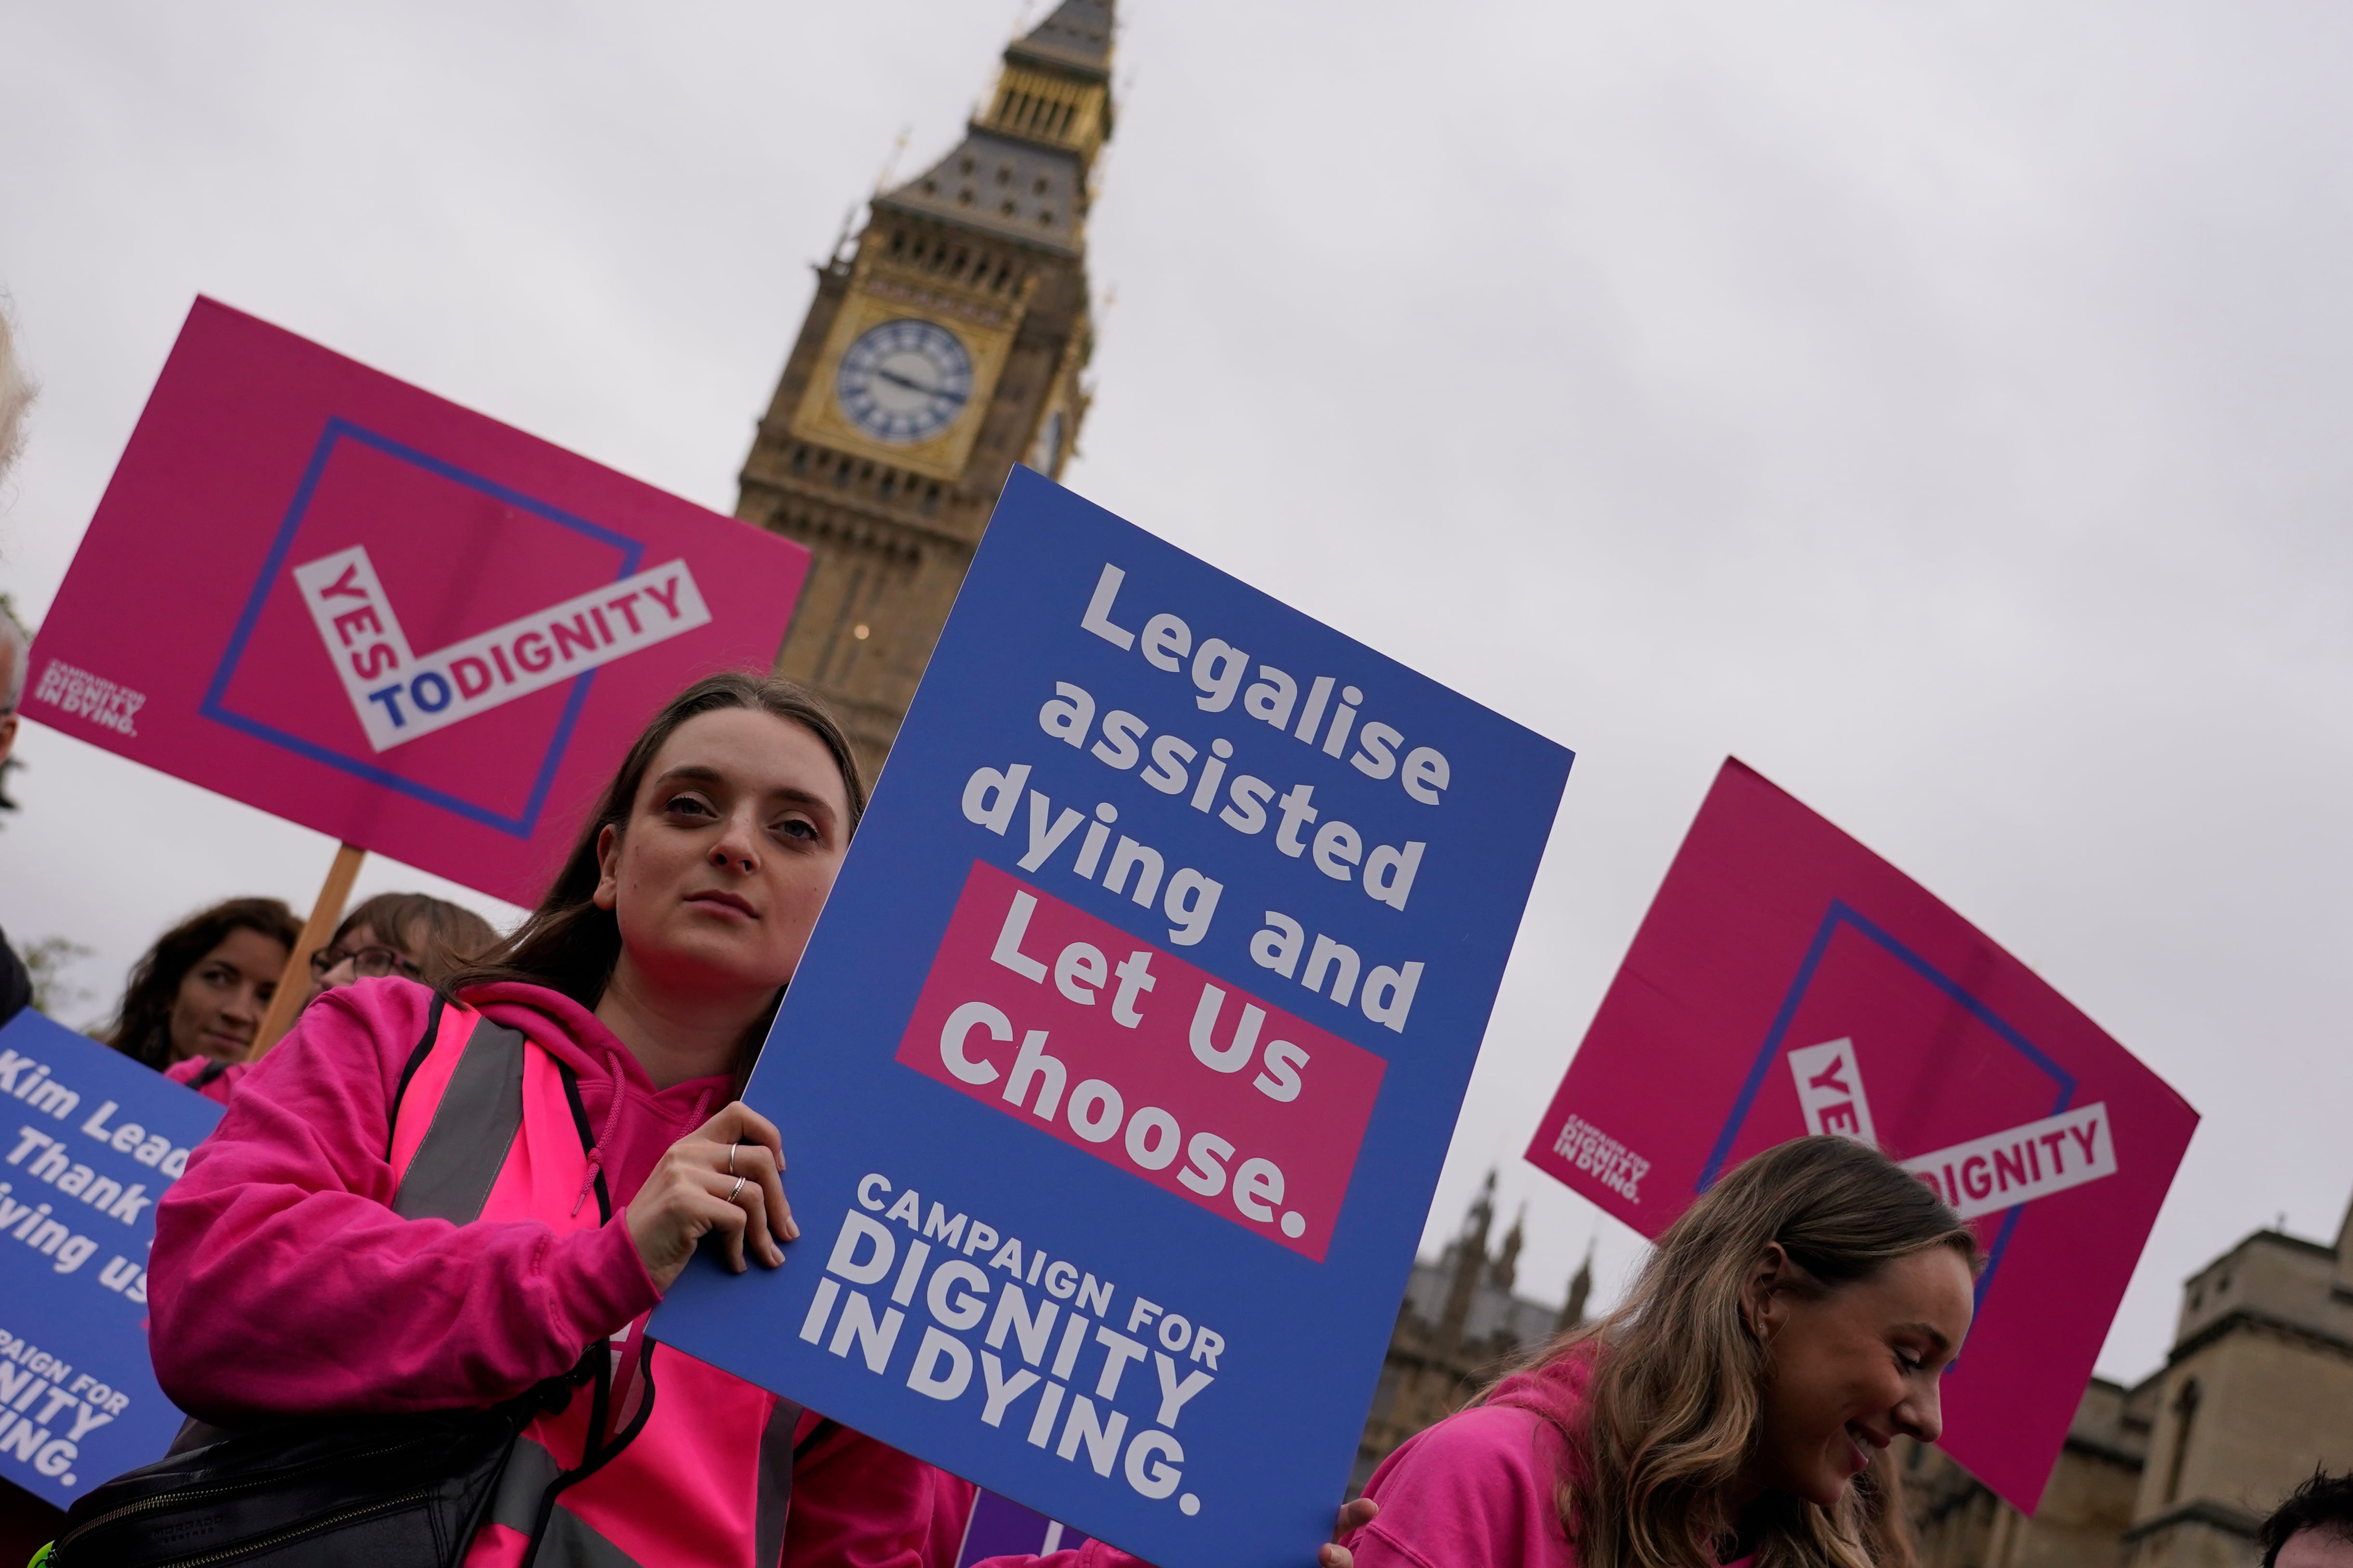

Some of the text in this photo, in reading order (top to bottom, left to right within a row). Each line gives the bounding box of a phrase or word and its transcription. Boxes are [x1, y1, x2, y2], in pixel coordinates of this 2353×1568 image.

[43, 666, 144, 717] DIGNITY
[319, 562, 400, 682] YES
[1080, 562, 1450, 805] Legalise
[1039, 681, 1427, 912] assisted
[962, 763, 1426, 1034] dying and
[990, 889, 1311, 1103] Let Us
[0, 1049, 80, 1120] Kim
[6, 1125, 152, 1225] Thank
[940, 1001, 1306, 1238] Choose.
[1561, 1122, 1647, 1183] DIGNITY
[1809, 1054, 1860, 1136] YE
[826, 1208, 1215, 1429] DIGNITY
[857, 1173, 1225, 1371] CAMPAIGN FOR
[69, 1373, 130, 1416] FOR
[799, 1276, 1201, 1516] IN DYING.
